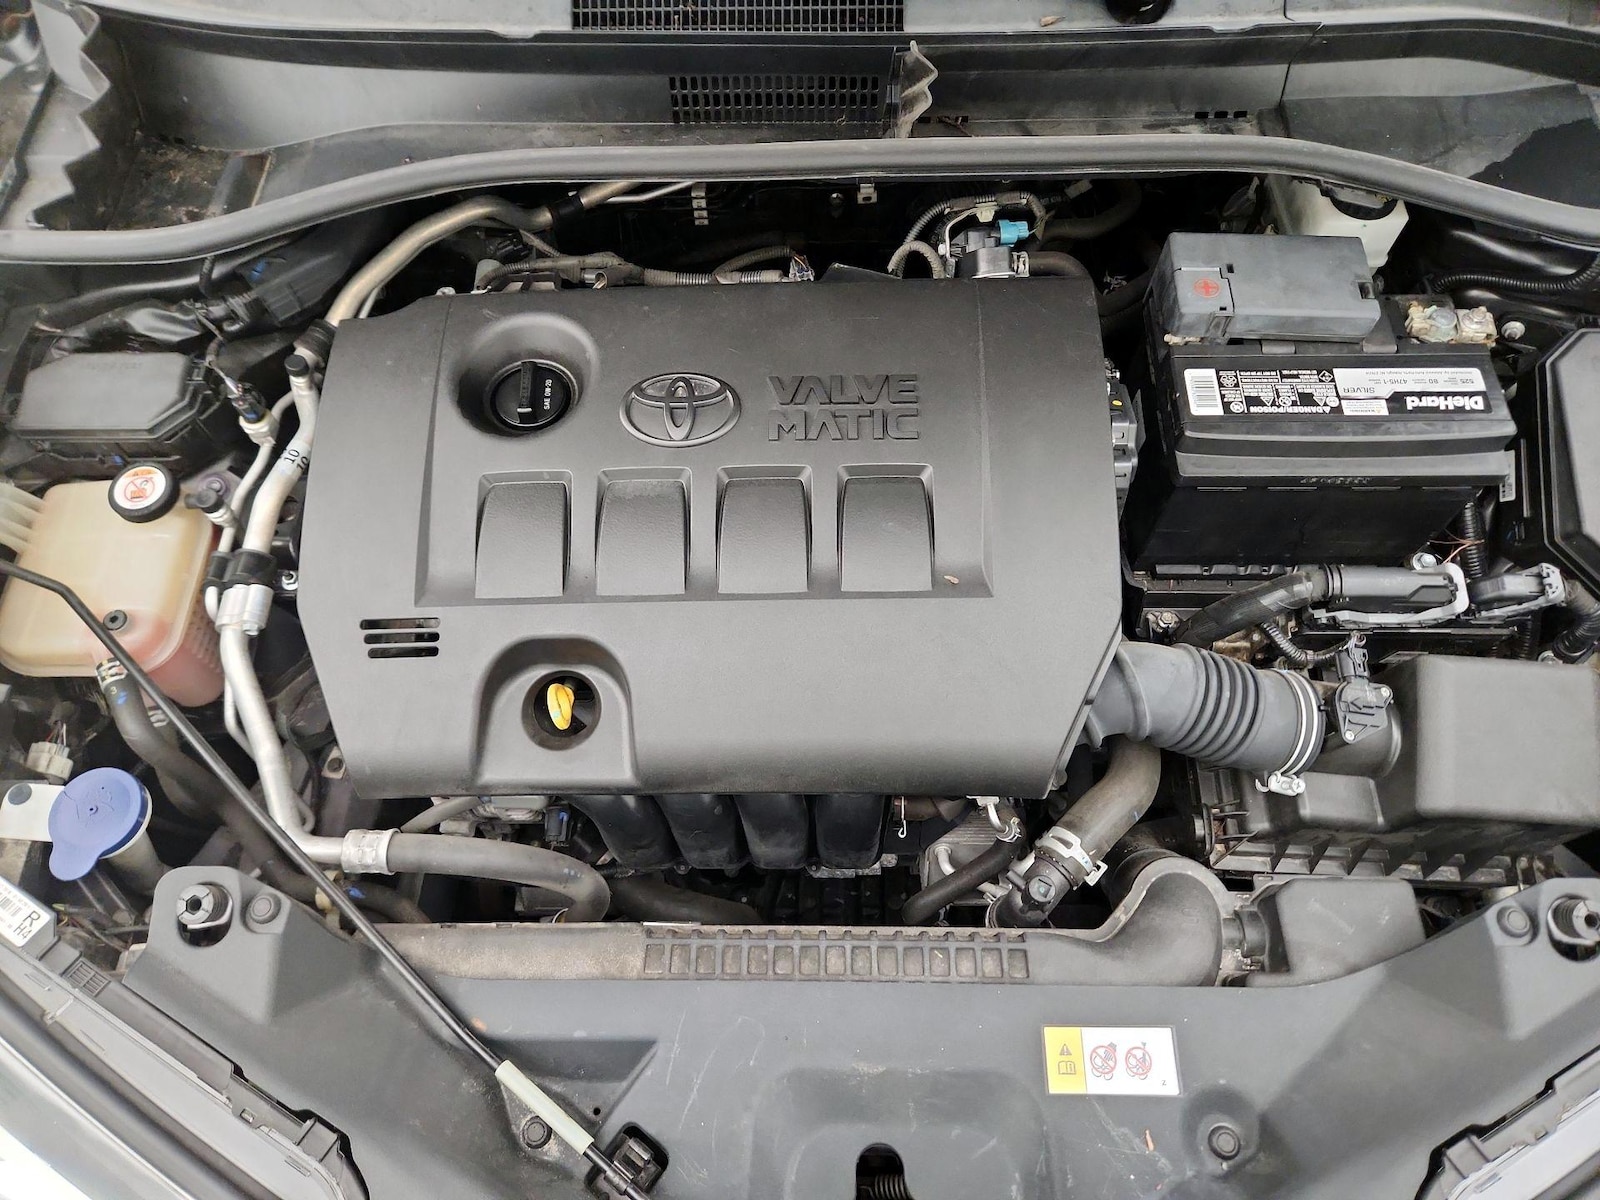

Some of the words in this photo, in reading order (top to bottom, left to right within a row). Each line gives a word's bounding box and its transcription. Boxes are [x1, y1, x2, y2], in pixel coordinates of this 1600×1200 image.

[768, 374, 920, 406] VALVE
[1343, 386, 1375, 394] SILVER
[543, 397, 551, 410] SAE
[1405, 395, 1485, 411] DieHard
[767, 407, 920, 442] MATIC
[23, 910, 41, 927] R
[13, 922, 32, 940] H4
